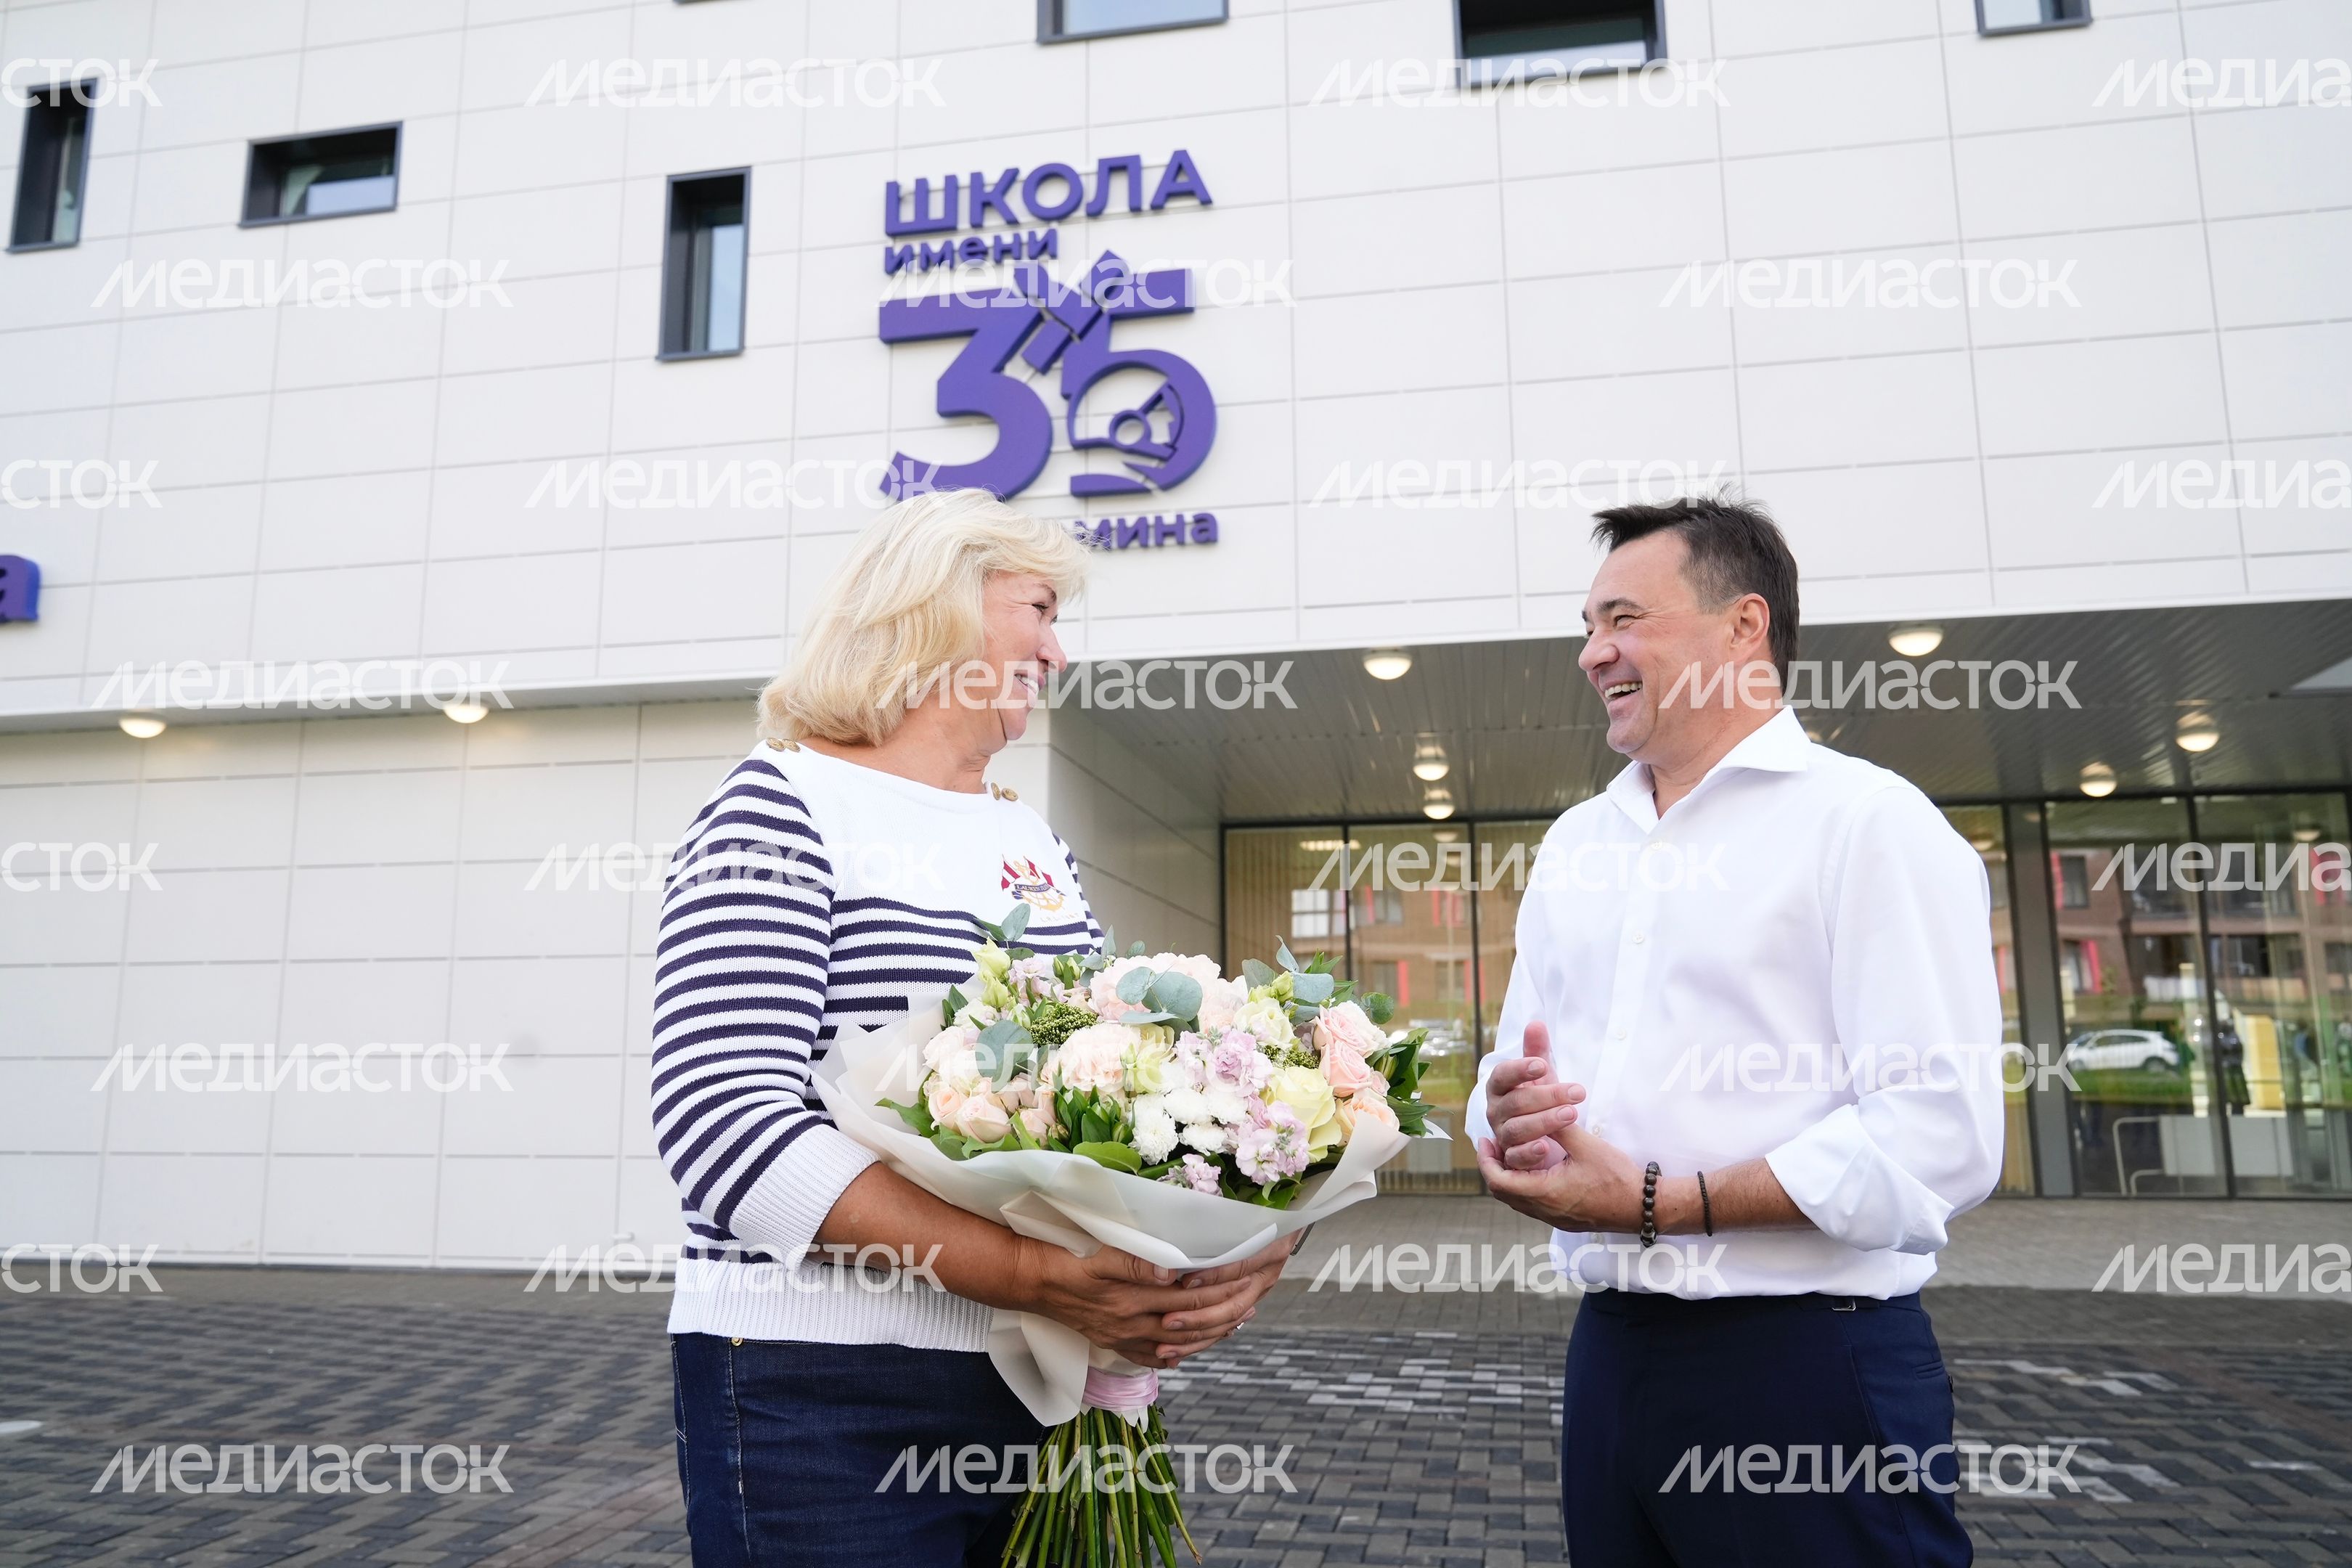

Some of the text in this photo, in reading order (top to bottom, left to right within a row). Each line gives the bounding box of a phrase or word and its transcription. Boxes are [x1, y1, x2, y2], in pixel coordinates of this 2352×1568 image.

[884, 150, 1213, 237] ШКОЛА
[884, 229, 1058, 276] имени
[878, 267, 1217, 502] 35
